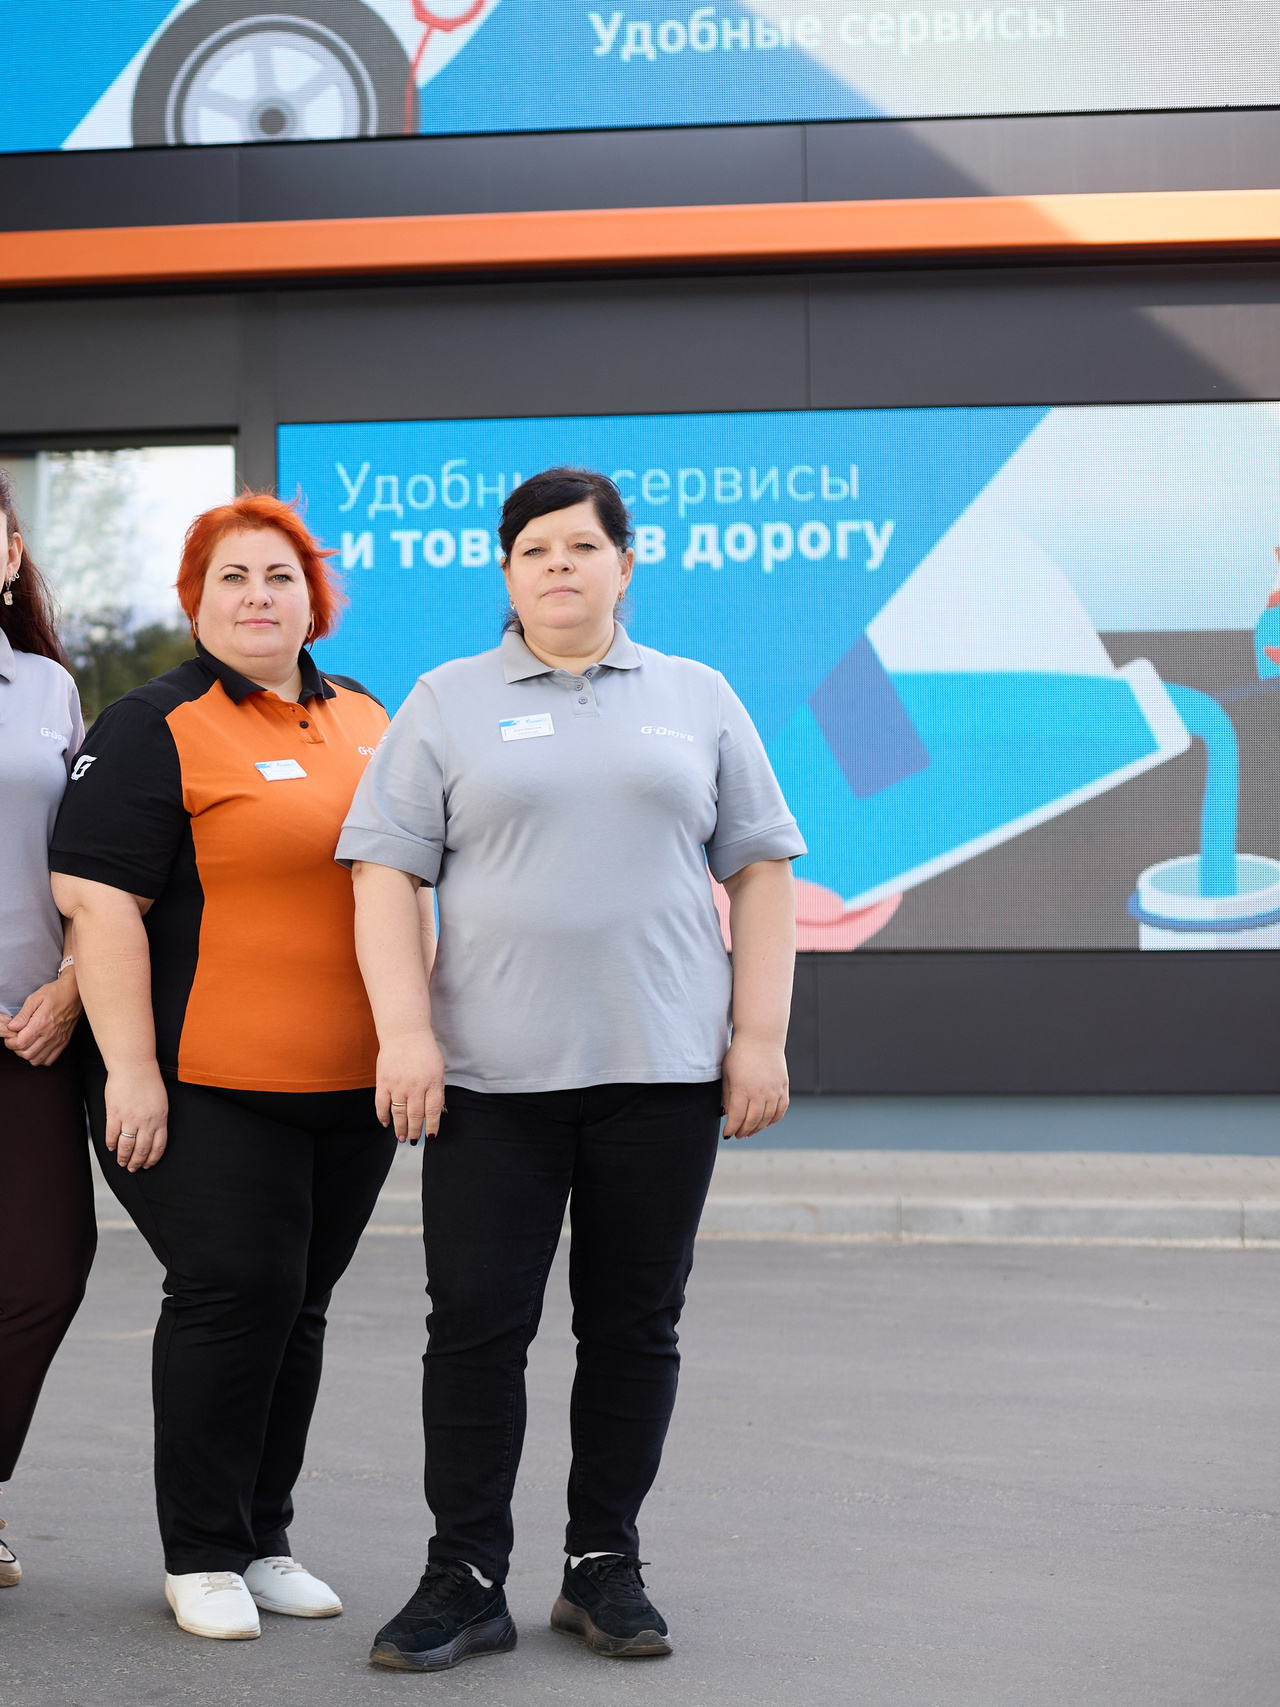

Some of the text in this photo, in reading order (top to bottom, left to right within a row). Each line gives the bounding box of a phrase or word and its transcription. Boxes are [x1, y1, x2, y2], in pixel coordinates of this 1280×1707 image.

[588, 5, 1065, 62] Удобные сервисы
[334, 459, 859, 519] Удобн сервисы
[341, 518, 896, 573] и тов в дорогу
